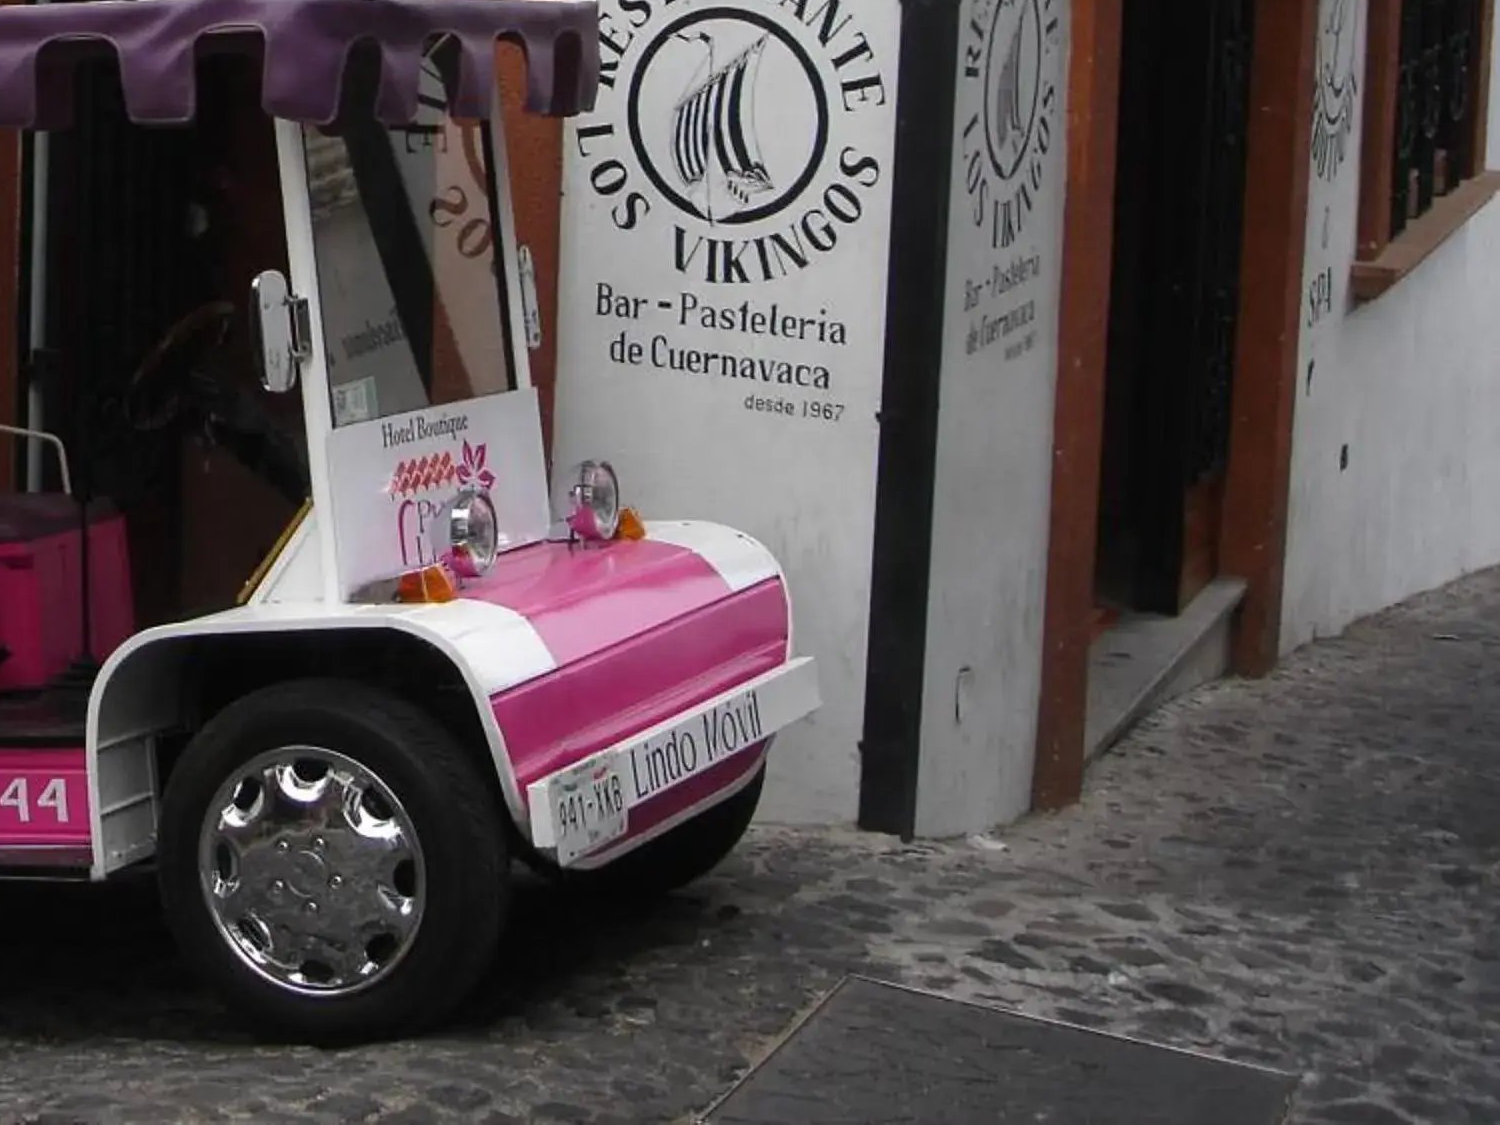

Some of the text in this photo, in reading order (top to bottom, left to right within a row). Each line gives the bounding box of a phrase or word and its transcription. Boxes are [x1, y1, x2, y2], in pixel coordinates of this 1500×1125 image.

[576, 123, 651, 230] LOS
[673, 146, 881, 284] VIKINGOS
[596, 282, 648, 320] Bar
[679, 292, 848, 345] Pasteleria
[610, 331, 831, 390] de Cuernavaca
[382, 413, 469, 448] Hotel Boutique
[744, 394, 846, 422] desde 1967
[629, 730, 697, 798] Lindo
[0, 778, 68, 823] 44
